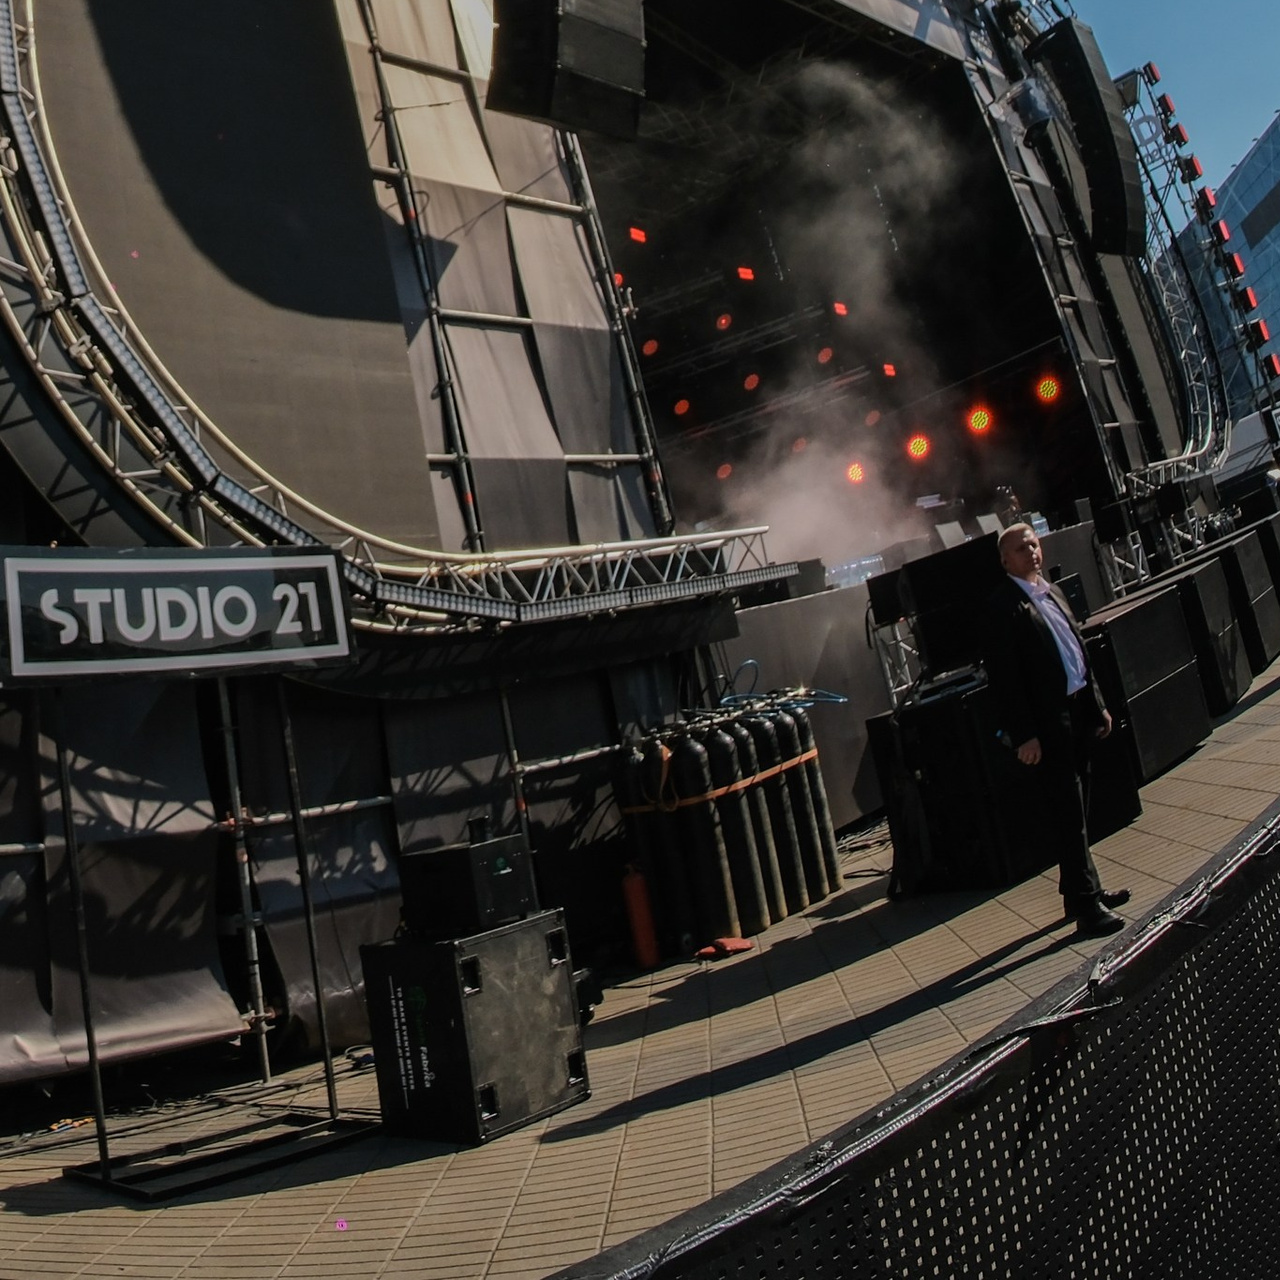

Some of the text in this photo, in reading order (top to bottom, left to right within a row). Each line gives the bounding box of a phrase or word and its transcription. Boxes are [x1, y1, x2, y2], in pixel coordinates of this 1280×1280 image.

[40, 582, 322, 645] STUDIO 21
[401, 1025, 410, 1057] EVENTS
[406, 1059, 415, 1090] BETTER
[420, 1046, 435, 1088] Fabrica
